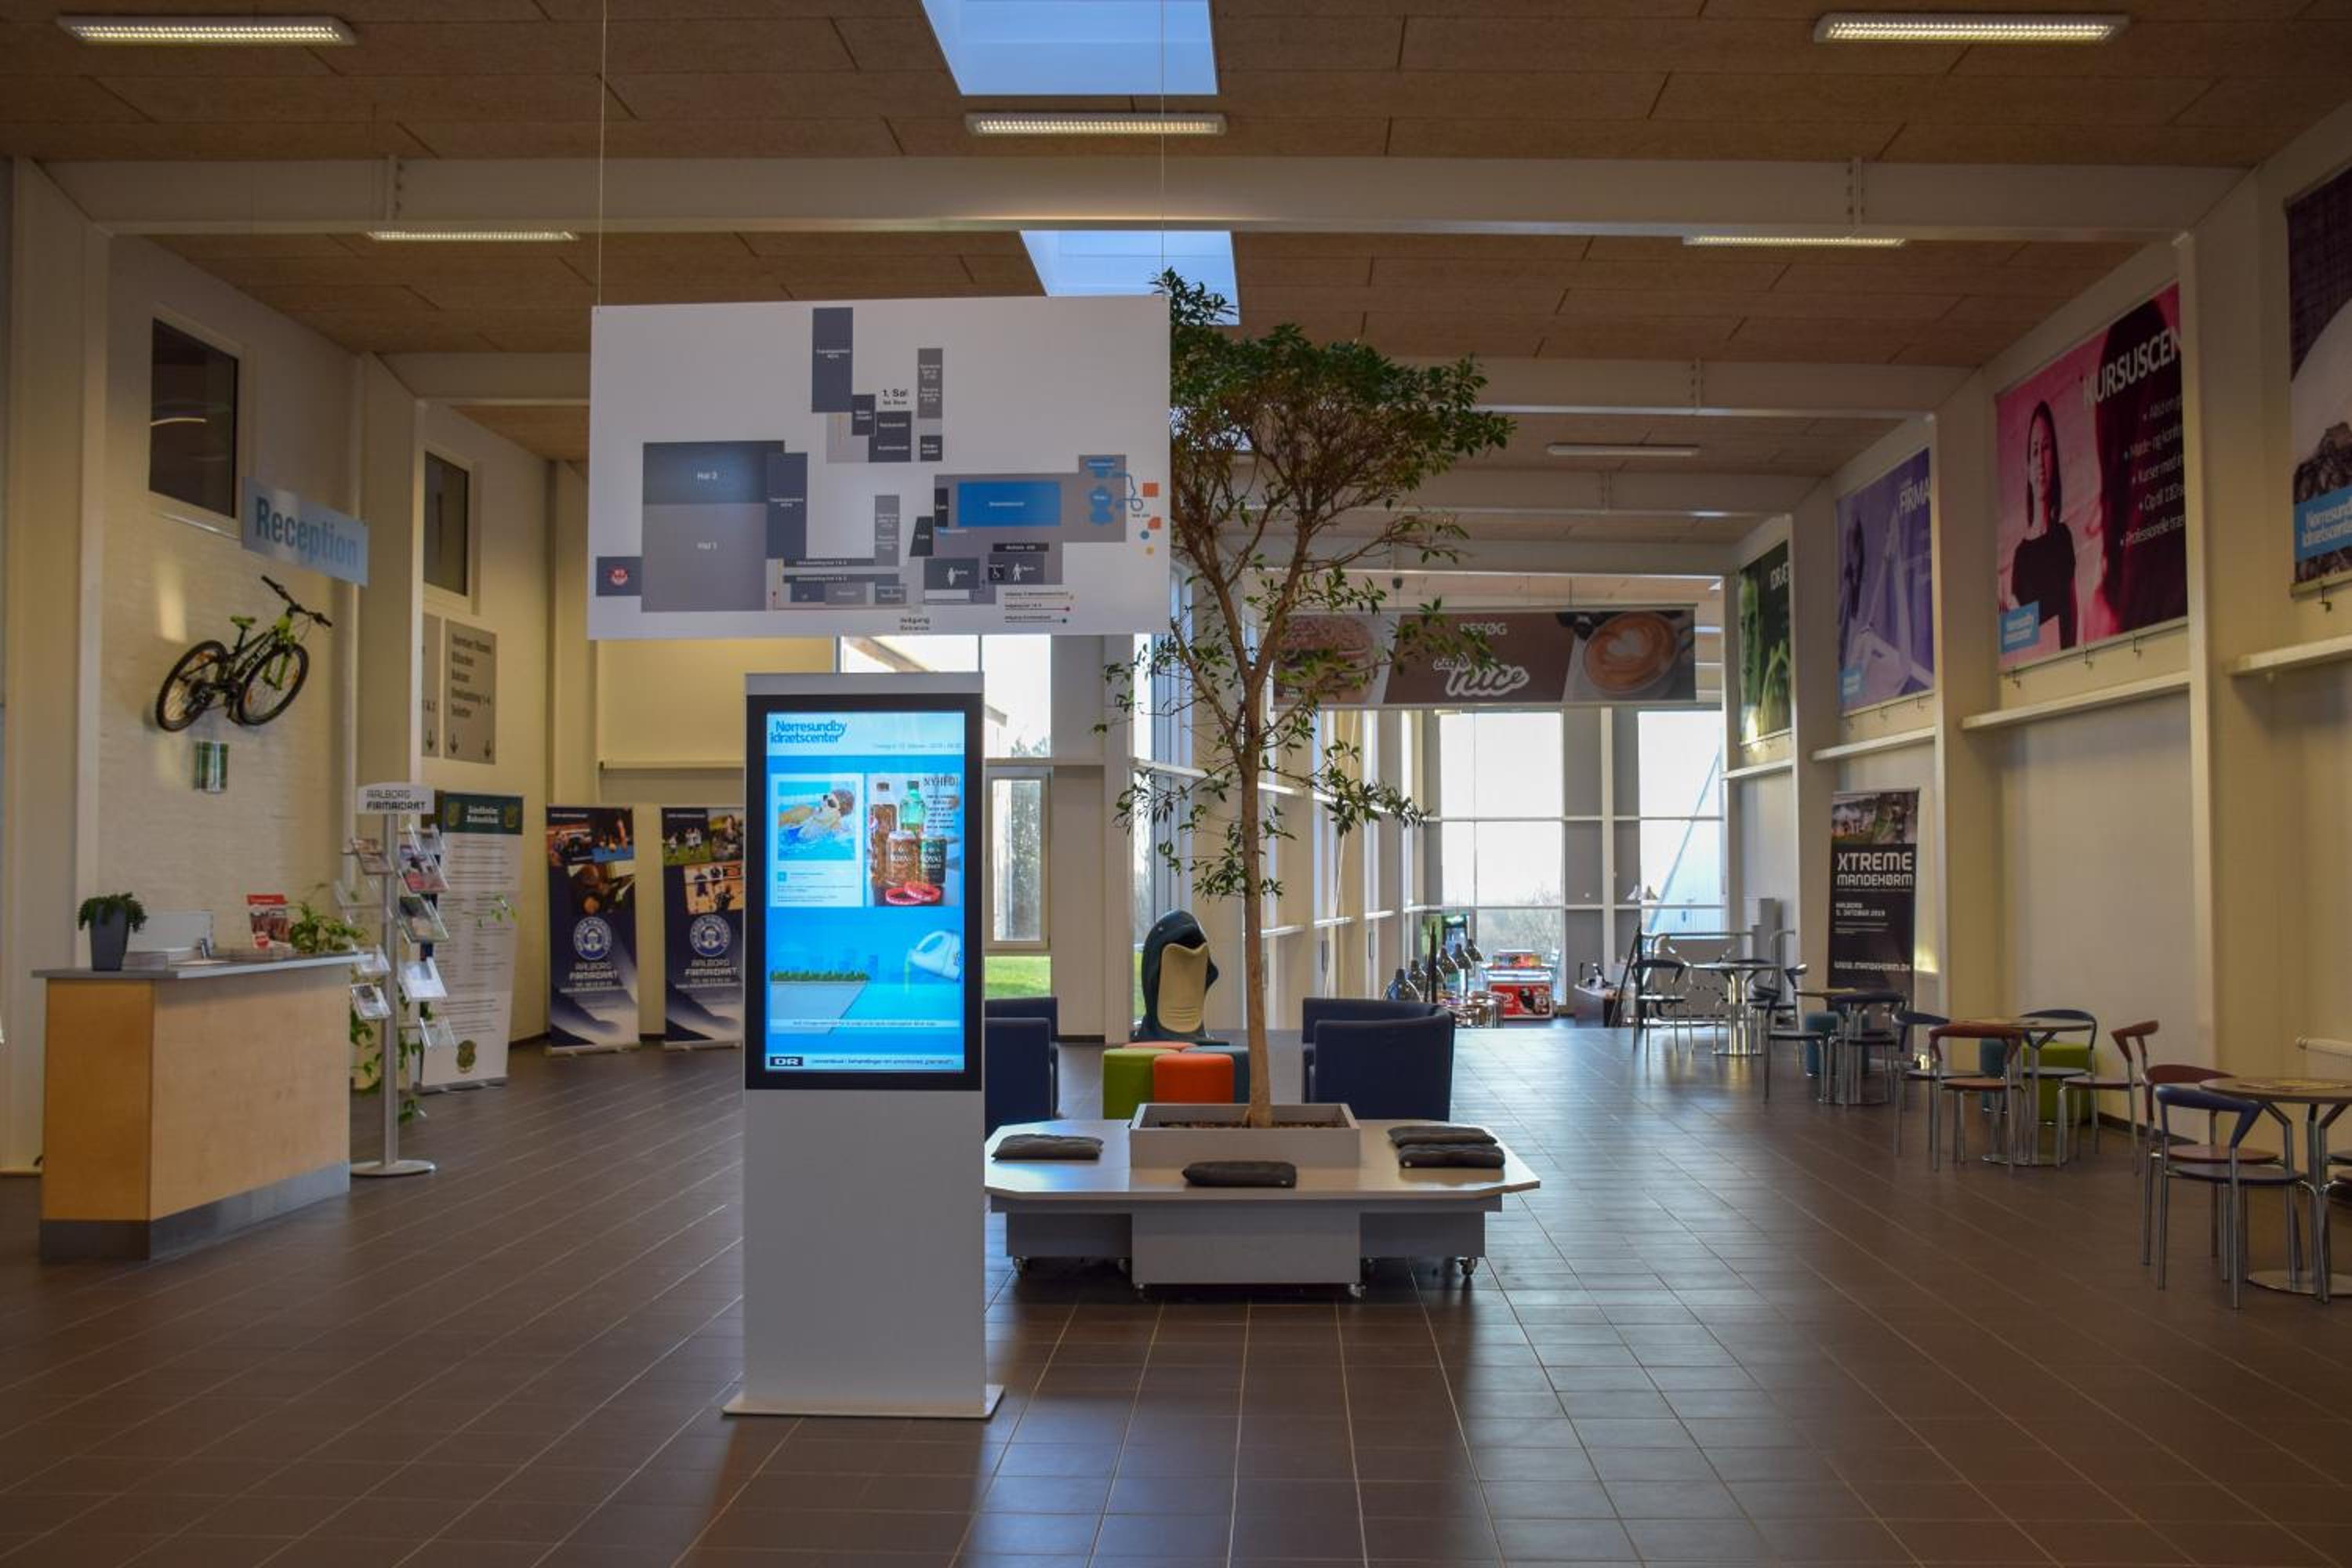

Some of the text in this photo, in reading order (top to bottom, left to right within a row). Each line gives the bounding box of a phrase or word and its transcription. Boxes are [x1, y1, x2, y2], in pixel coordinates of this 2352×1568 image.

[256, 496, 358, 568] Reception
[365, 789, 411, 799] AALBORG
[1837, 852, 1913, 872] XTREME
[1836, 874, 1913, 887] MANDEHØRM
